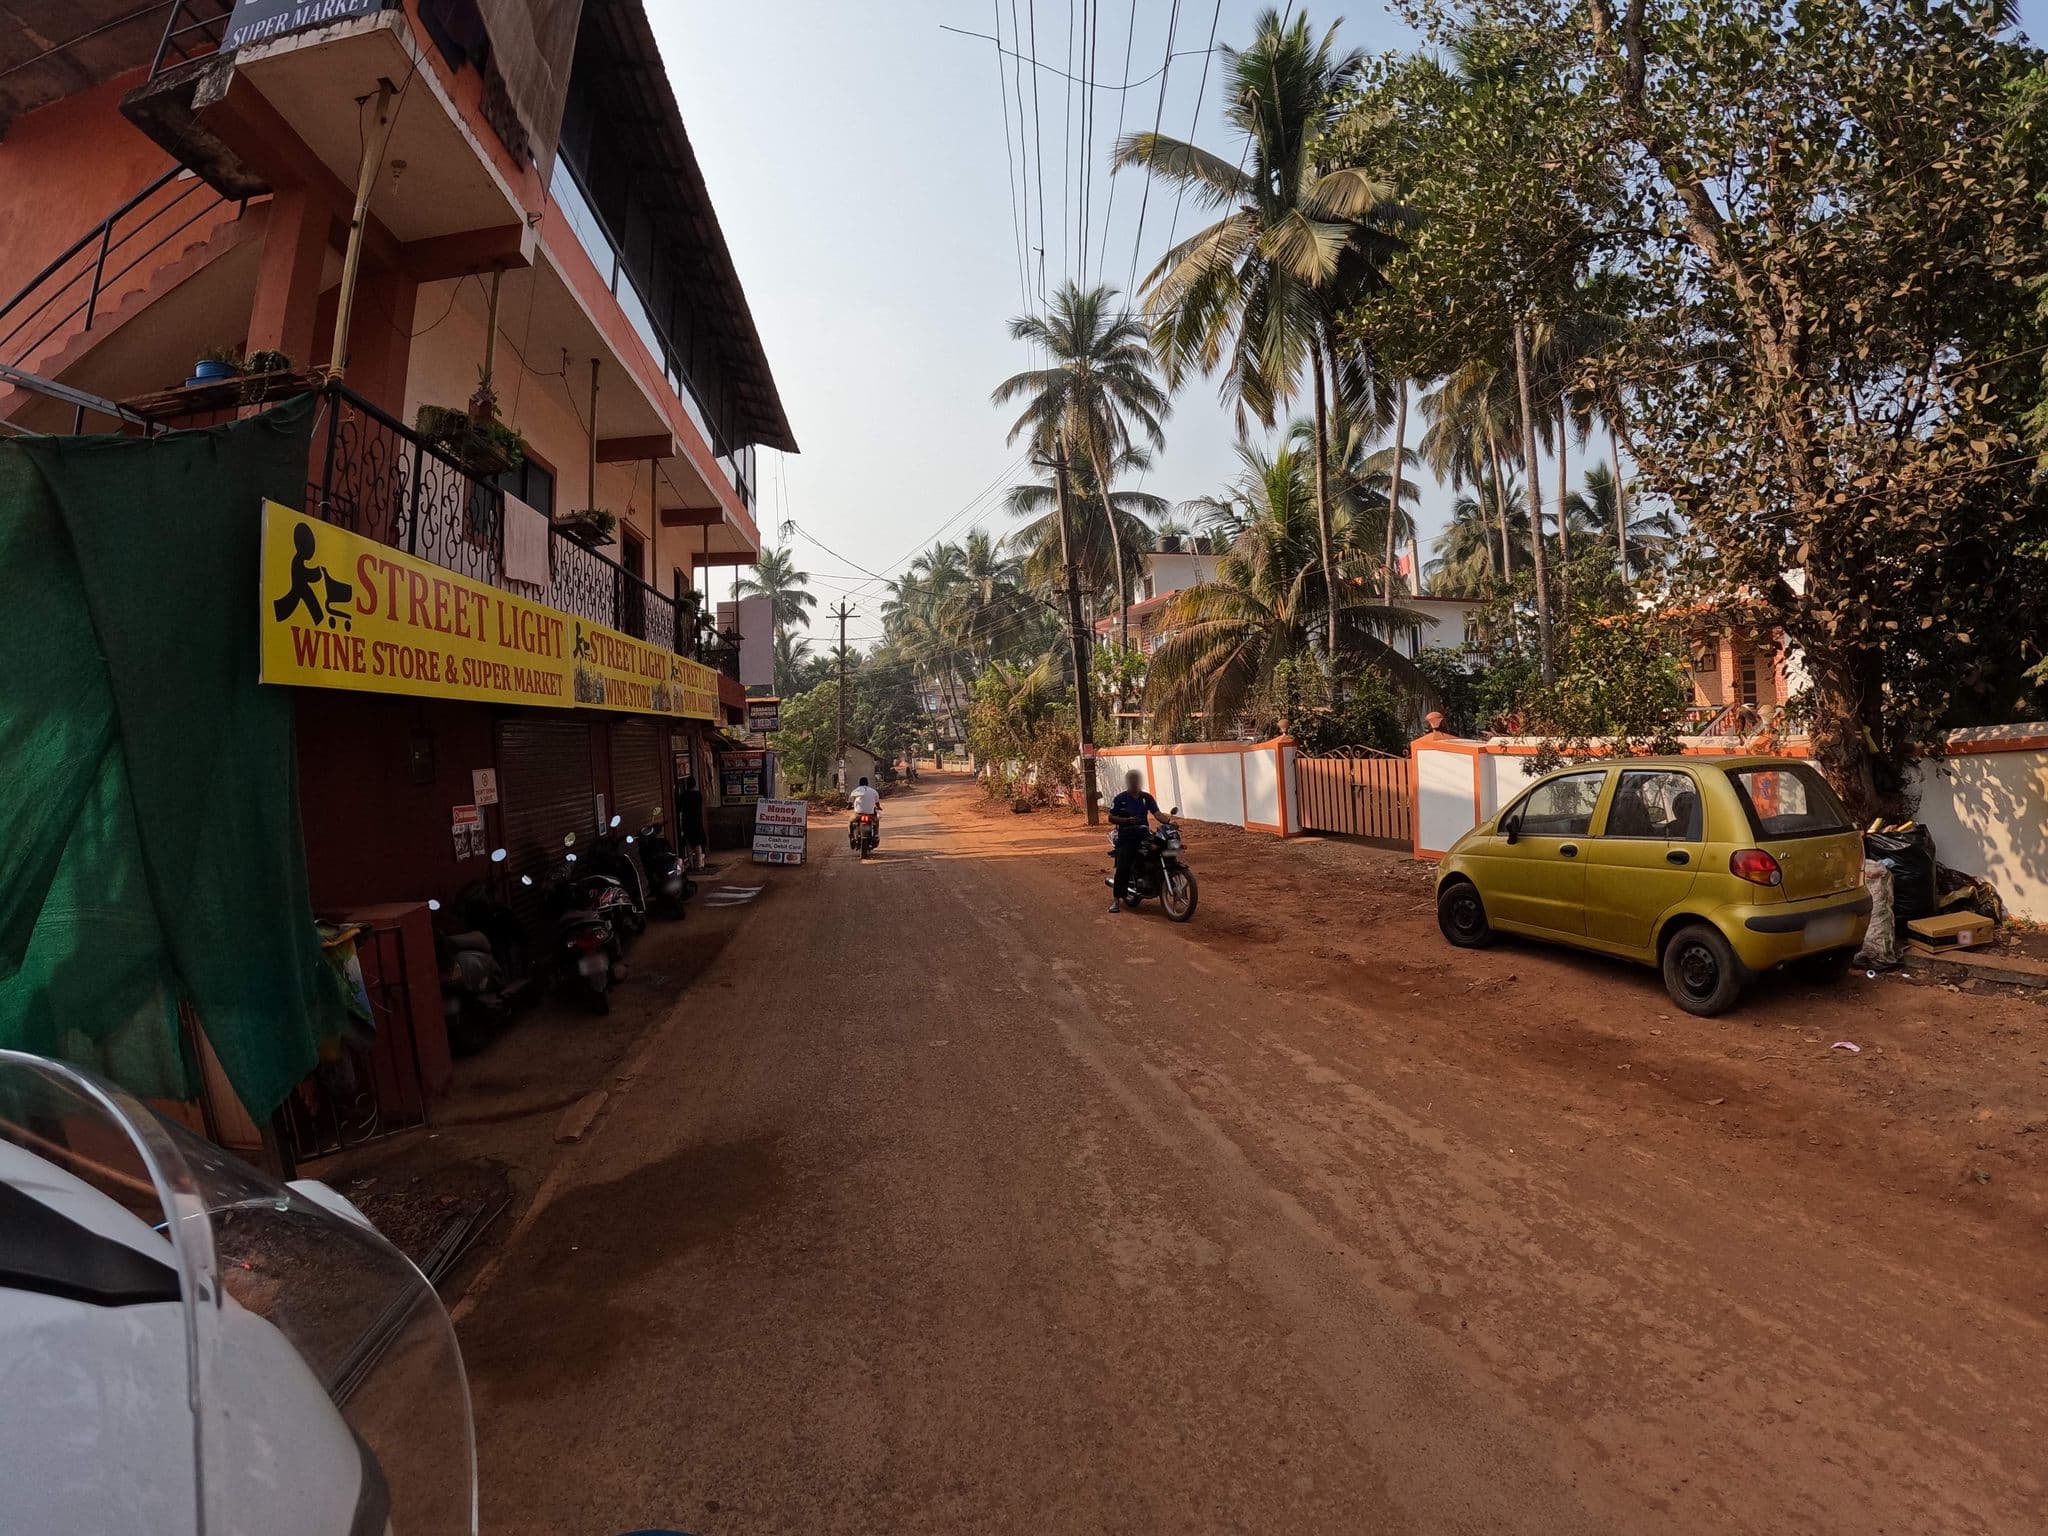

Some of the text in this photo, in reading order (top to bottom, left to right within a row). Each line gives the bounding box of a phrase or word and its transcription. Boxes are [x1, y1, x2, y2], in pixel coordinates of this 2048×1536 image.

[230, 0, 369, 48] SUPER MARKET
[356, 553, 565, 659] STREET LIGHT
[291, 625, 563, 697] WINE STORE & SUPER MARKET
[589, 630, 666, 681] STREET LIGHT
[604, 677, 652, 709] WINE STORE
[760, 813, 802, 824] Exchange
[768, 804, 796, 815] Money
